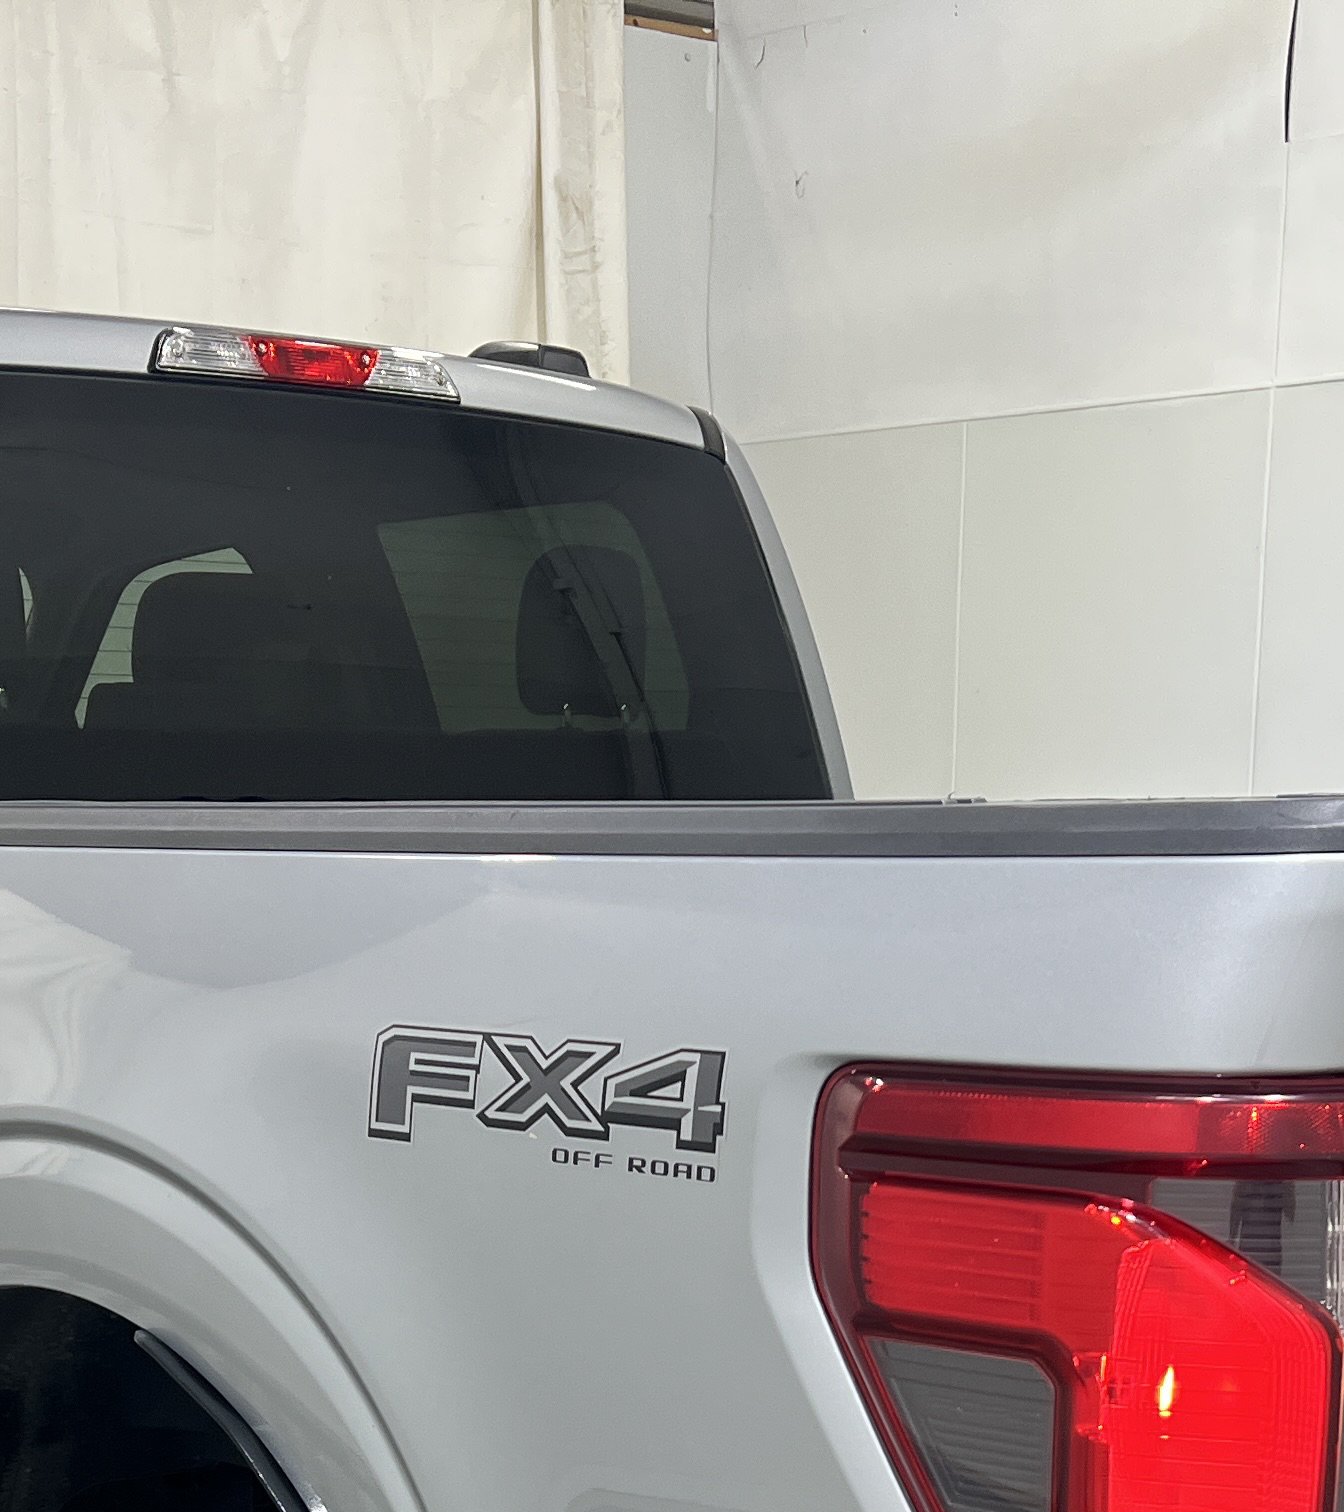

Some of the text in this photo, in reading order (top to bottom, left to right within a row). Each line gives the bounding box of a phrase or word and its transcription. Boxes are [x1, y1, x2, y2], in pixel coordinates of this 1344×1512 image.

[368, 1024, 727, 1153] FX4
[551, 1147, 717, 1183] OFF ROAD
